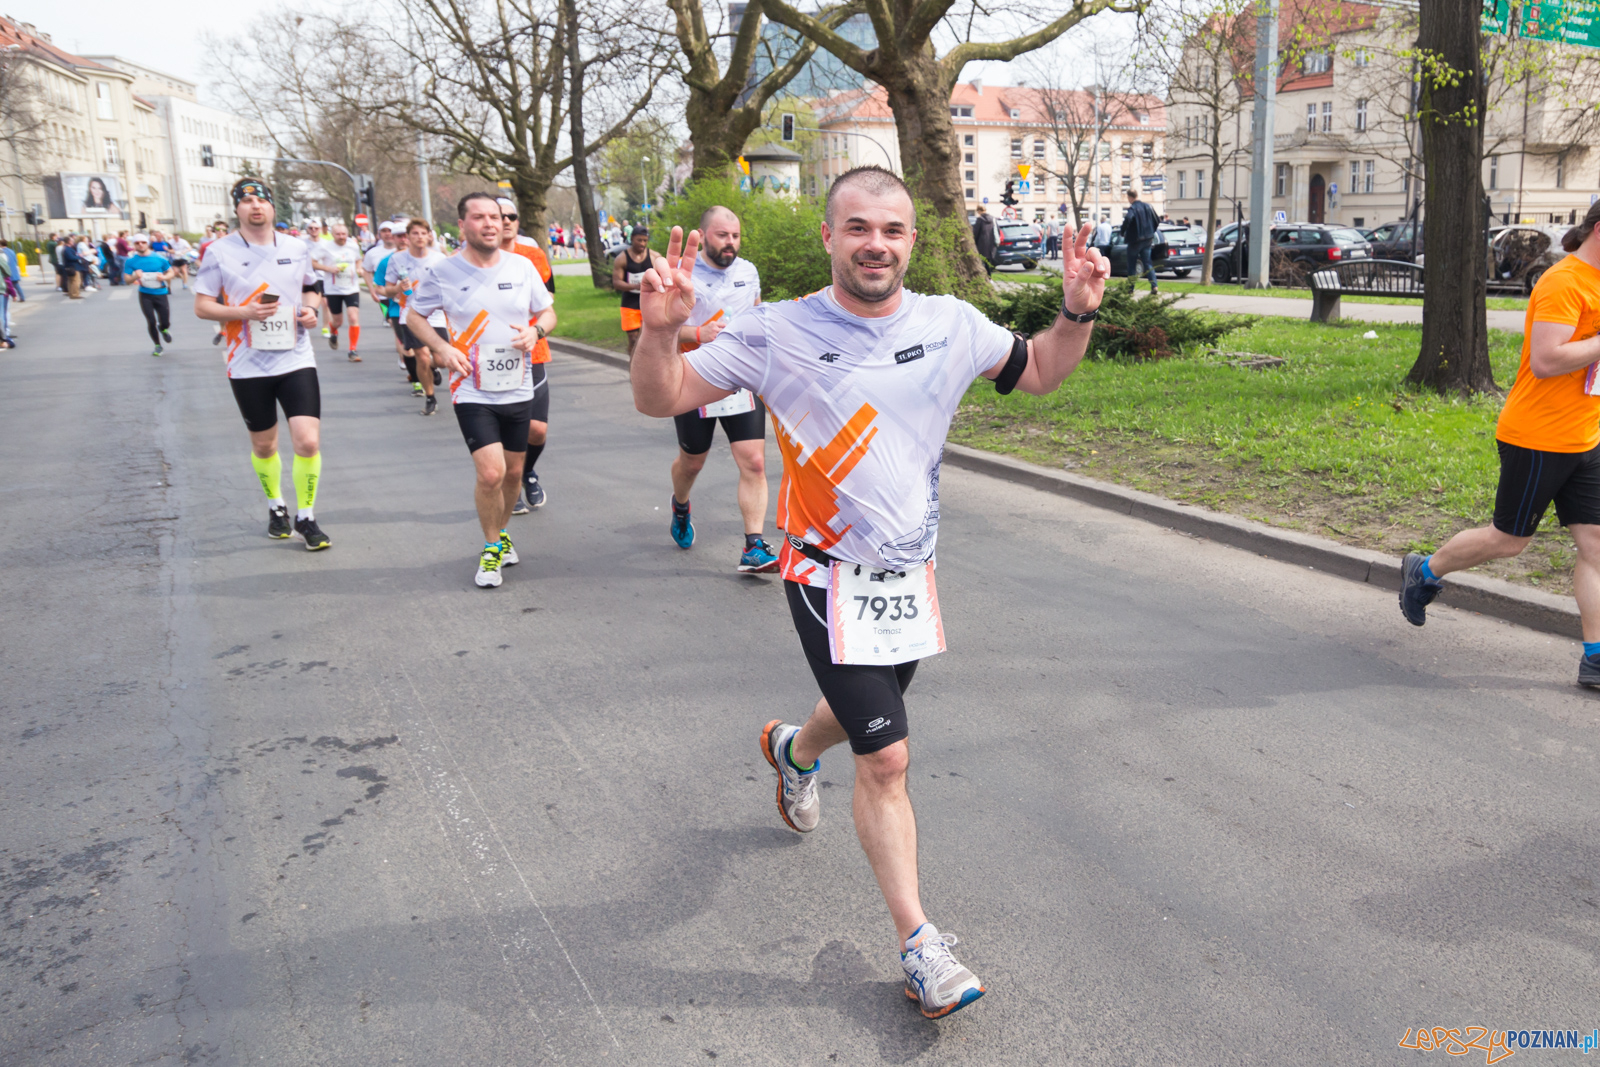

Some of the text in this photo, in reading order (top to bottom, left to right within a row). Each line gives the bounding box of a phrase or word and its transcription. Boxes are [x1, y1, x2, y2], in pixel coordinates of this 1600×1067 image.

[259, 320, 289, 332] 3191
[819, 351, 841, 363] 4F
[486, 357, 521, 372] 3607
[853, 594, 919, 621] 7933
[873, 626, 902, 635] Tomasz
